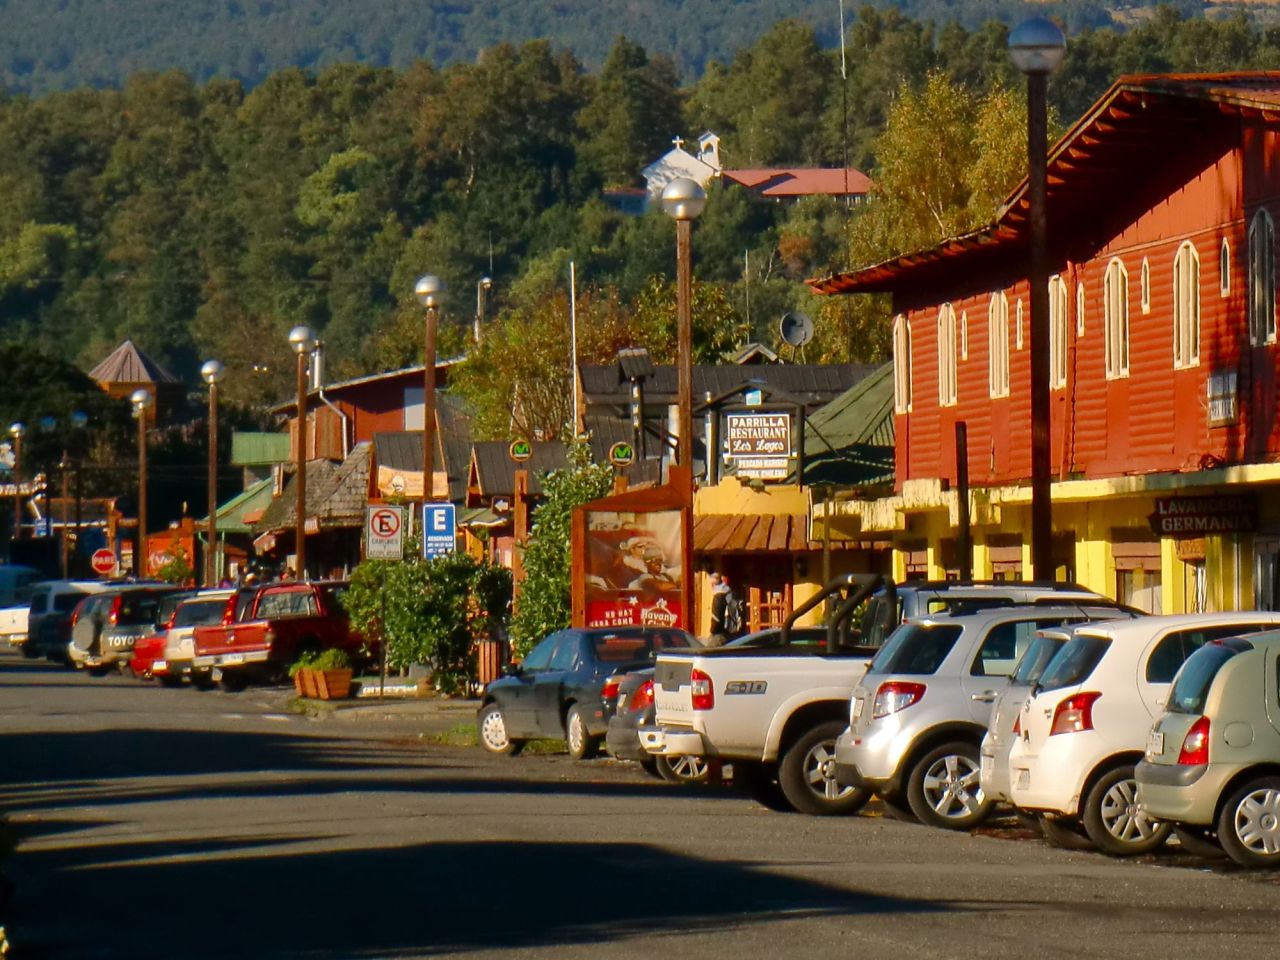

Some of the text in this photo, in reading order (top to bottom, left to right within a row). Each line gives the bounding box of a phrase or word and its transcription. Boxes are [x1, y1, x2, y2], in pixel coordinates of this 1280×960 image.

[732, 417, 785, 428] PARRILLA
[730, 427, 787, 439] RESTAURANT
[733, 439, 752, 452] Los
[434, 509, 446, 531] E
[1161, 515, 1253, 532] GERMANIA
[641, 607, 678, 624] Havana
[108, 634, 146, 646] TOYO
